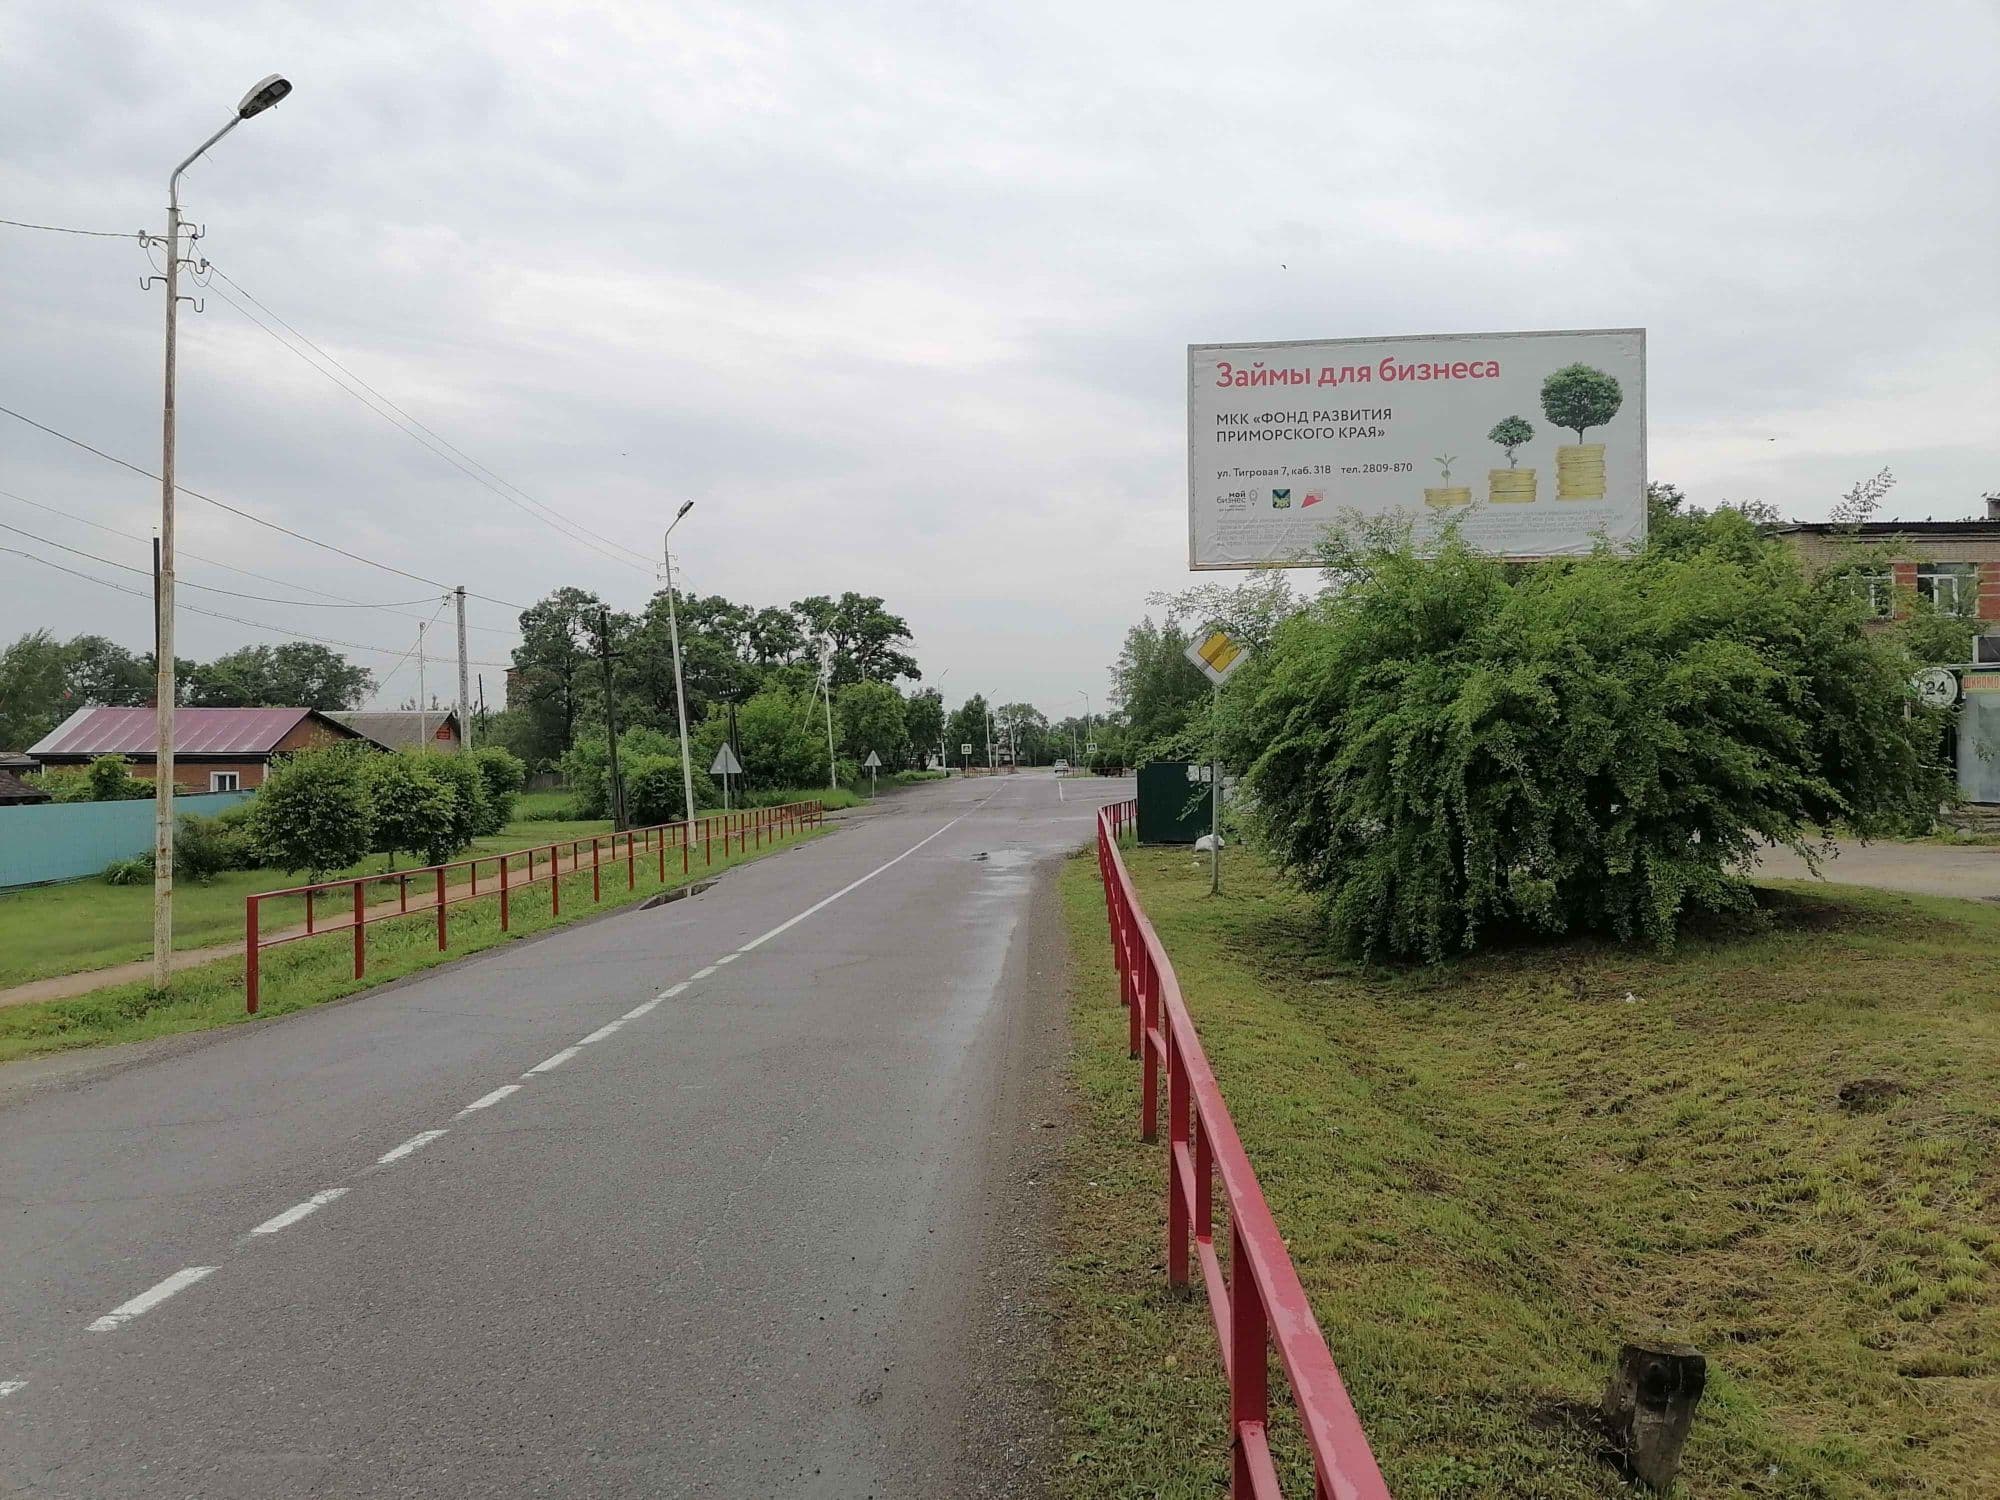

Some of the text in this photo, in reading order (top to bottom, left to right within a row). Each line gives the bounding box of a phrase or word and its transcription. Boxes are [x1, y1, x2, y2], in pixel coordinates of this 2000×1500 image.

[1216, 356, 1500, 388] Займы для бизнеса
[1216, 408, 1392, 425] МКК «ФОНД РАЗВИТИЯ
[1216, 426, 1385, 443] ПРИМОРСКОГО КРАЯ»
[1217, 462, 1413, 480] ул. Тигровая 7, каб. 318 тел. 2809-870
[1926, 680, 1947, 695] 24
